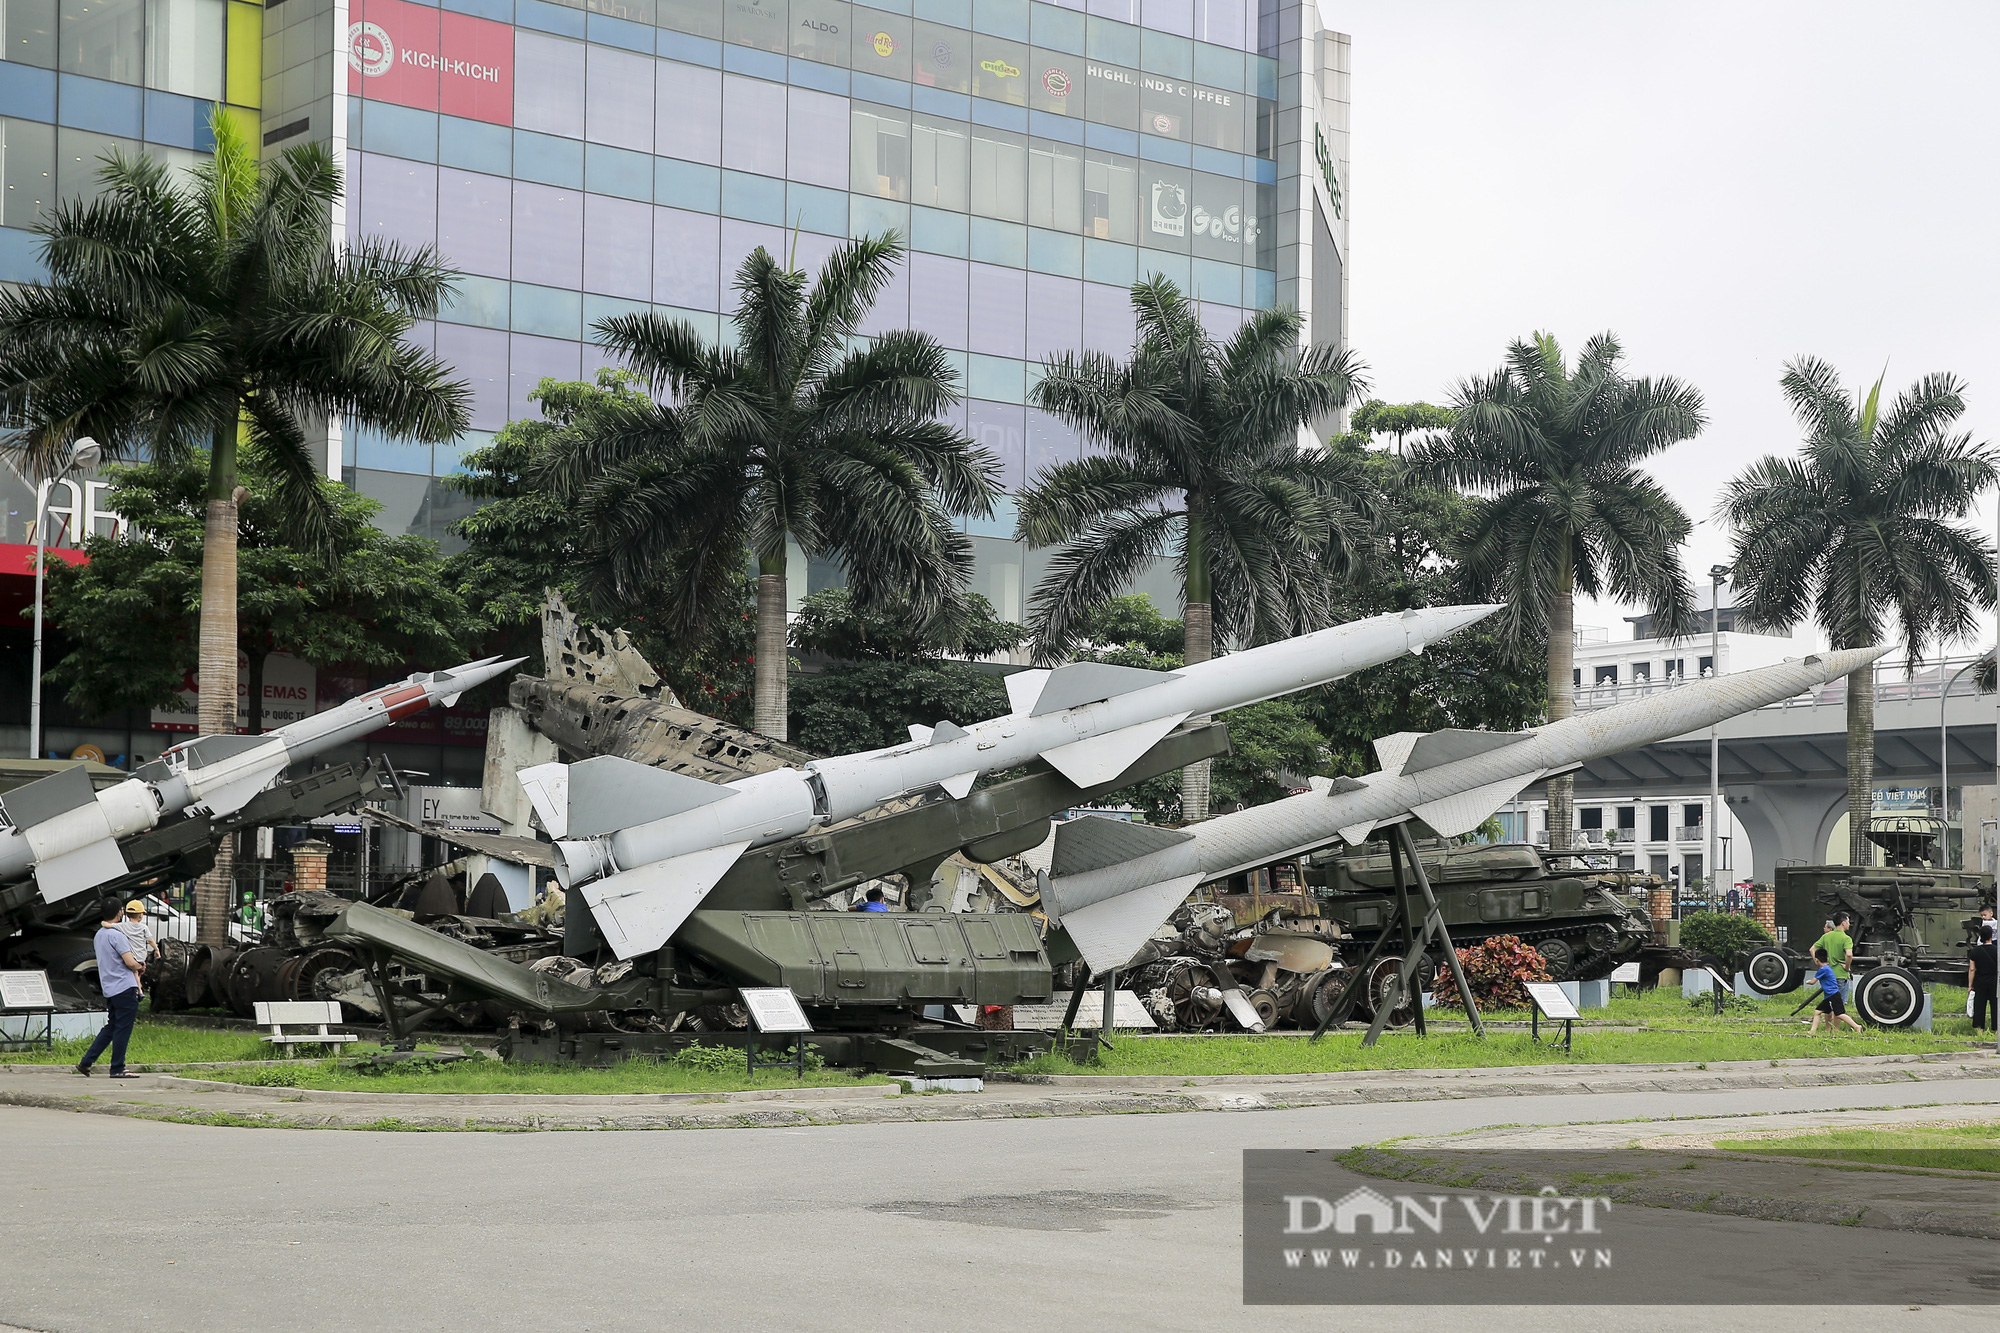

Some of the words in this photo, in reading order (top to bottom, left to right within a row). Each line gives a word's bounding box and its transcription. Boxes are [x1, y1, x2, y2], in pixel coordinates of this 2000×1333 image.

[736, 4, 776, 20] SWAROVSKI
[801, 19, 839, 34] ALDO
[865, 33, 883, 45] Hard
[402, 48, 499, 83] KICHI-KICHI
[1044, 68, 1071, 85] HIGHLANDS
[1046, 86, 1068, 97] COFFEE
[237, 683, 308, 700] CIEMAS
